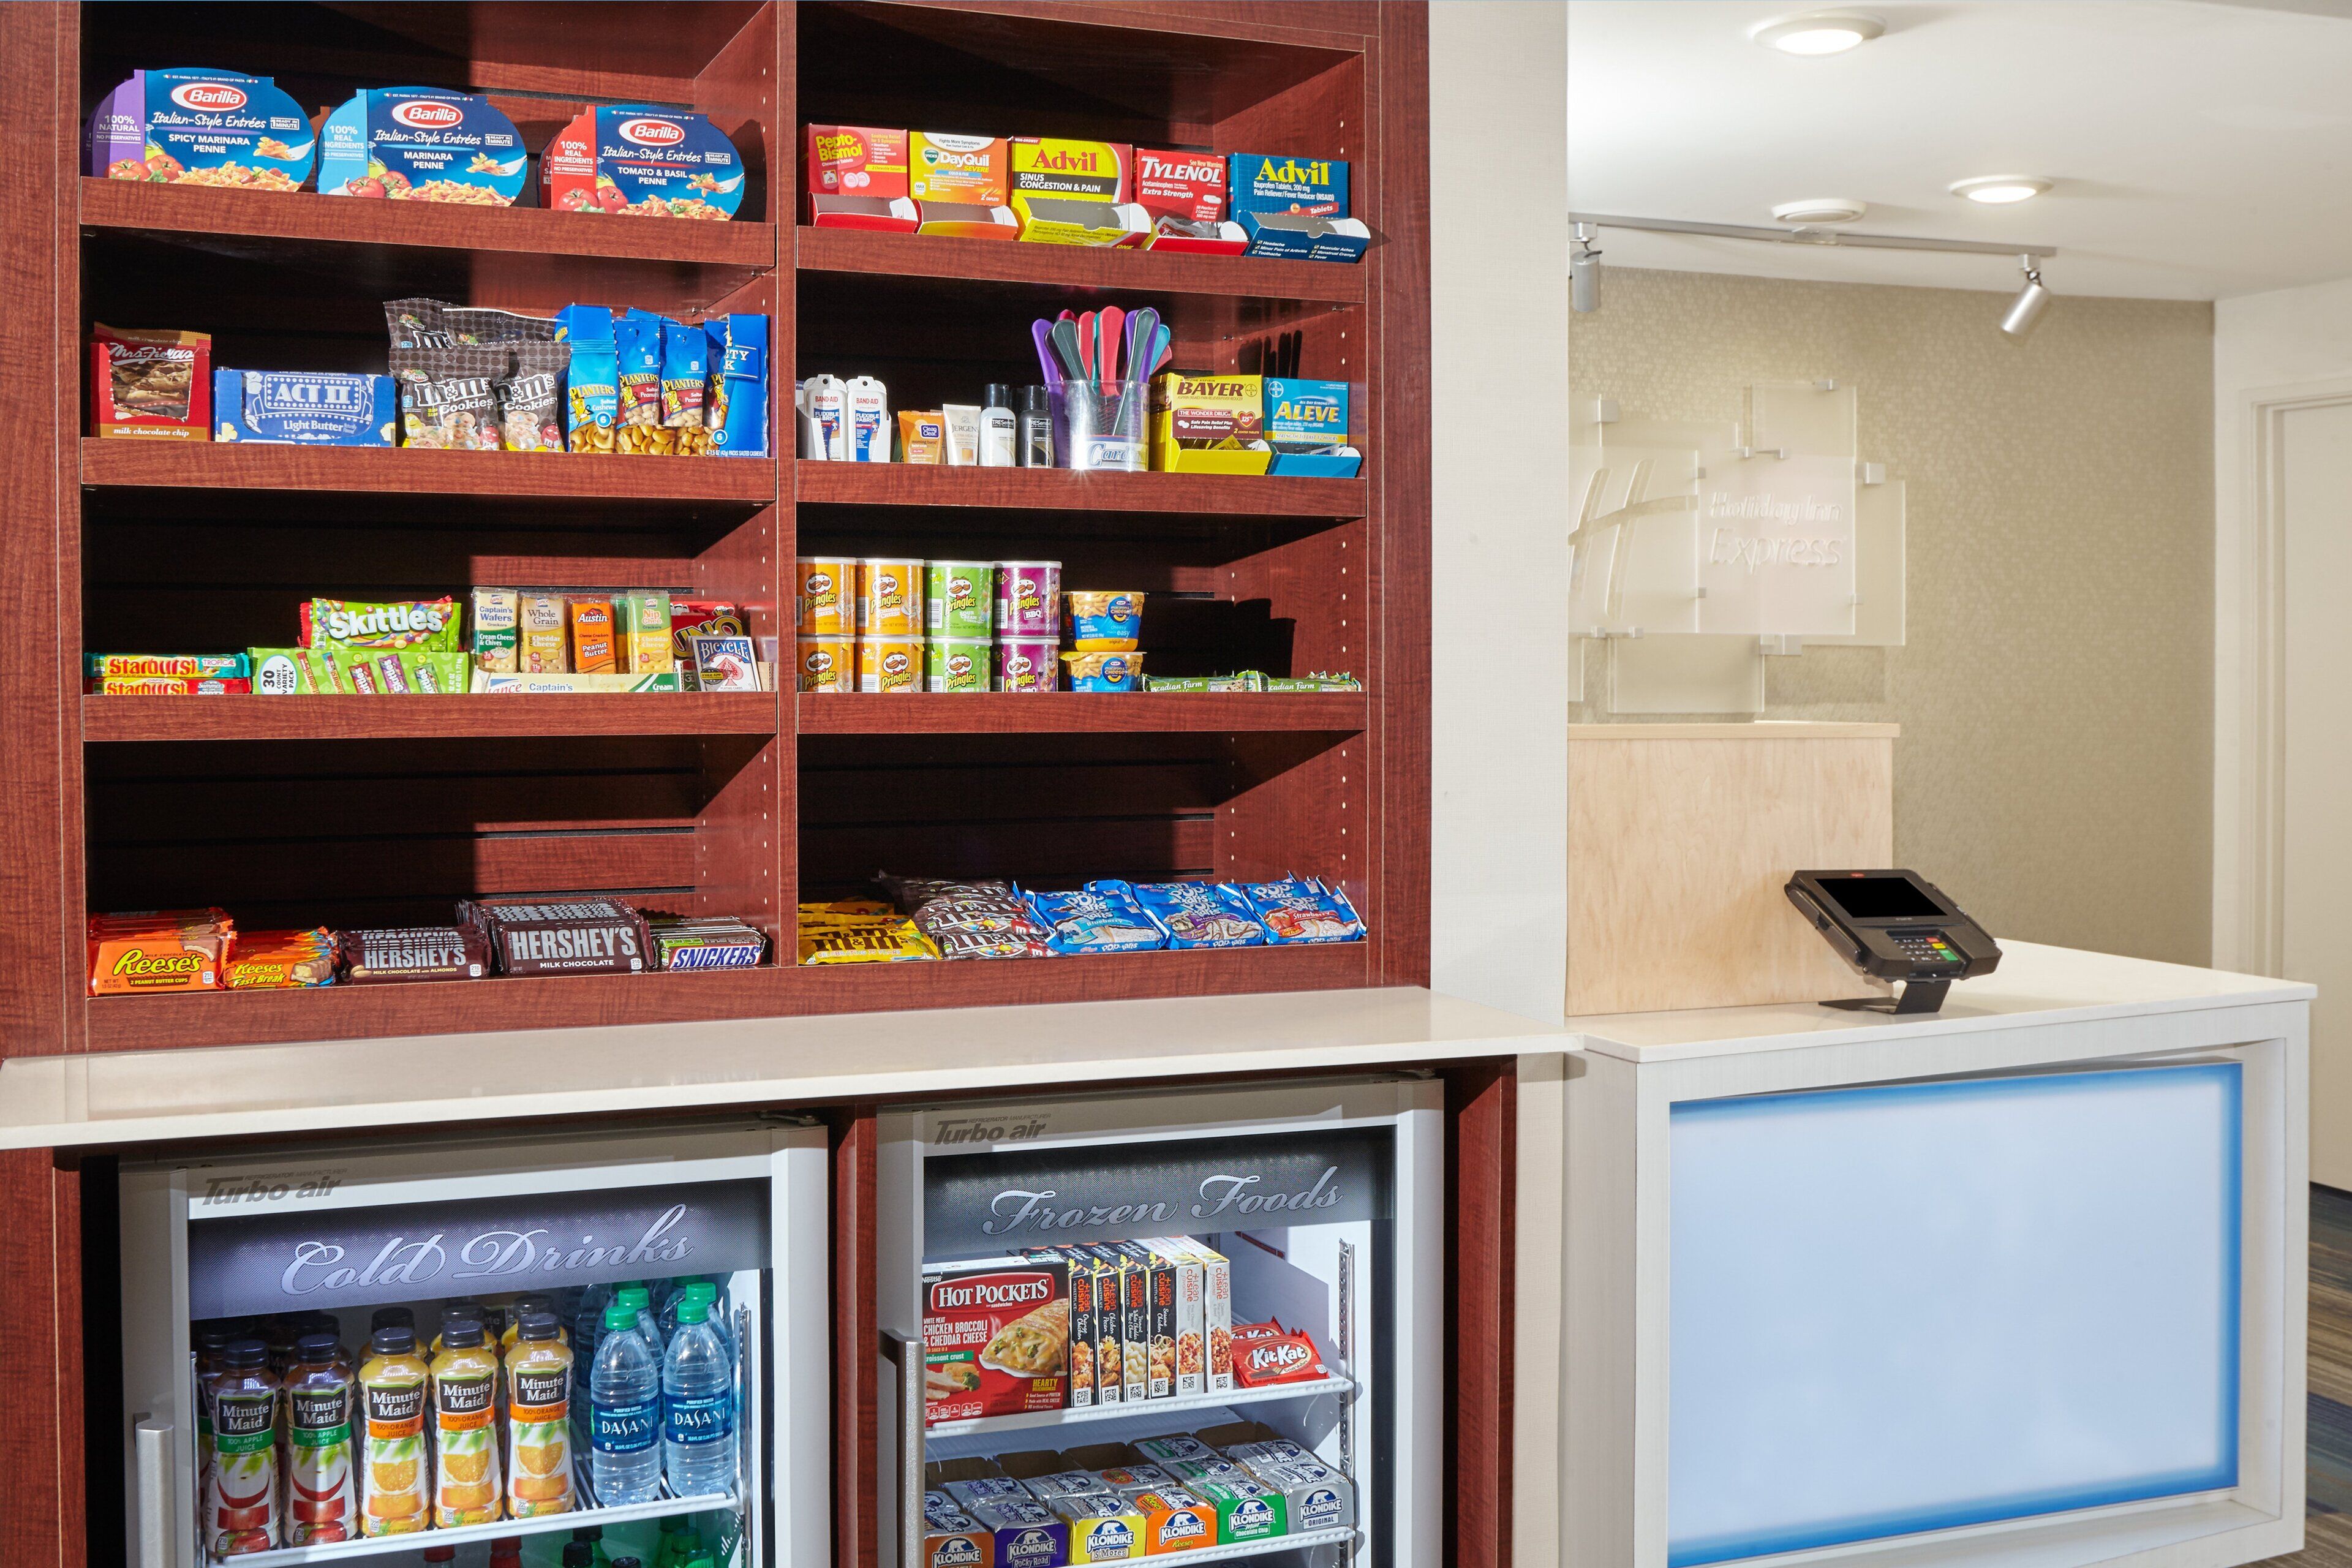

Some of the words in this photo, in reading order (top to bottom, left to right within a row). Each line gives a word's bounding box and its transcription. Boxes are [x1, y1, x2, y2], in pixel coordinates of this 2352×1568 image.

[189, 89, 241, 104] Barilla
[104, 115, 135, 124] 100%
[151, 111, 223, 130] Italian-Style
[225, 115, 267, 129] Entrées
[409, 107, 457, 123] Barilla
[99, 123, 140, 132] NATURAL
[329, 125, 358, 135] 100%
[634, 125, 679, 140] Barilla
[168, 134, 196, 143] SPICY
[198, 135, 251, 146] MARINARA
[323, 141, 365, 150] INGREDIENTS
[374, 129, 441, 148] Italian-Style
[443, 132, 483, 146] Entrées
[560, 141, 587, 151] 100%
[815, 134, 857, 149] Pepto-
[193, 145, 227, 154] PENNE
[404, 151, 454, 161] MARINARA
[601, 146, 664, 164] Italian-Style
[666, 149, 703, 163] Entrées
[818, 144, 864, 162] Bismol
[413, 161, 445, 170] PENNE
[554, 156, 594, 165] INGREDIENTS
[940, 152, 990, 168] DayQuil
[1031, 148, 1098, 172] Advil
[617, 167, 655, 176] TOMATO
[656, 168, 663, 177] &
[665, 170, 688, 178] BASIL
[1020, 173, 1045, 182] SINUS
[1141, 157, 1222, 184] TYLENOL
[1254, 157, 1331, 186] Advil
[638, 177, 668, 186] PENNE
[1020, 180, 1073, 190] CONGESTION
[1081, 184, 1101, 193] PAIN
[1142, 181, 1174, 189] Acetaminophen
[1142, 188, 1163, 197] Extra
[1163, 190, 1194, 199] Strength
[1264, 190, 1297, 199] Reliever/Fever
[1297, 192, 1316, 200] Reducer
[1316, 194, 1335, 202] (NSAID)
[1310, 205, 1333, 214] Tablets
[274, 383, 321, 404] ACT
[325, 385, 352, 404] II
[568, 385, 616, 402] PLANTERS
[663, 379, 704, 393] PLANTERS
[1176, 382, 1245, 396] BAYER
[439, 397, 494, 415] Cookies
[1273, 401, 1340, 423] ALEVE
[172, 429, 189, 438] chip
[283, 420, 311, 432] Light
[311, 421, 344, 432] Butter
[1708, 491, 1801, 526] Holiday
[1806, 494, 1842, 521] Inn
[1708, 527, 1843, 575] Express
[804, 590, 837, 613] Pringles
[527, 609, 556, 618] Whole
[577, 613, 608, 623] Austin
[642, 609, 661, 618] Nip
[1025, 610, 1042, 619] BBQ
[328, 605, 443, 639] Skittles
[533, 617, 559, 626] Grain
[581, 642, 608, 652] Peanut
[584, 648, 608, 658] Butter
[700, 641, 750, 663] BICYCLE
[108, 658, 198, 674] Starburst
[263, 669, 275, 688] 30
[881, 671, 913, 692] Pringles
[529, 683, 573, 692] Captain's
[1086, 918, 1123, 927] Blueberry
[511, 926, 638, 960] HERSHEY'S
[112, 948, 205, 976] Reese's
[364, 947, 466, 969] HERSHEY'S
[562, 959, 615, 968] CHOCOLATE
[673, 946, 760, 968] SNICKERS
[933, 1119, 1005, 1145] Turbo
[1009, 1120, 1047, 1141] air
[202, 1175, 290, 1206] Turbo
[295, 1176, 344, 1200] air
[981, 1189, 1178, 1235] Frozen
[1190, 1165, 1344, 1219] Foods
[281, 1233, 447, 1296] Cold
[451, 1203, 696, 1279] Drinks
[938, 1285, 974, 1308] HOT
[975, 1279, 1048, 1305] POCKETS
[923, 1322, 953, 1335] CHICKEN
[955, 1319, 988, 1333] BROCCOLI
[923, 1338, 929, 1347] &
[930, 1334, 960, 1346] CHEDDAR
[962, 1332, 988, 1344] CHEESE
[1251, 1344, 1307, 1370] KitKat
[1032, 1378, 1058, 1387] HEARTY
[371, 1390, 421, 1405] Minute
[222, 1403, 270, 1420] Minute
[296, 1398, 343, 1414] Minute
[378, 1403, 414, 1417] Maid
[228, 1416, 264, 1431] Maid
[303, 1412, 337, 1425] Maid
[390, 1422, 417, 1430] ORANGE
[674, 1407, 725, 1430] DASANI
[385, 1429, 407, 1438] JUICE
[601, 1415, 654, 1438] DASANI
[1298, 1499, 1343, 1523] KLONDIKE
[1229, 1510, 1275, 1532] KLONDIKE
[1308, 1517, 1335, 1526] ORIGINAL
[1159, 1522, 1205, 1545] KLONDIKE
[1087, 1531, 1135, 1555] KLONDIKE
[1008, 1540, 1056, 1562] KLONDIKE
[1093, 1547, 1128, 1558] S'Mores
